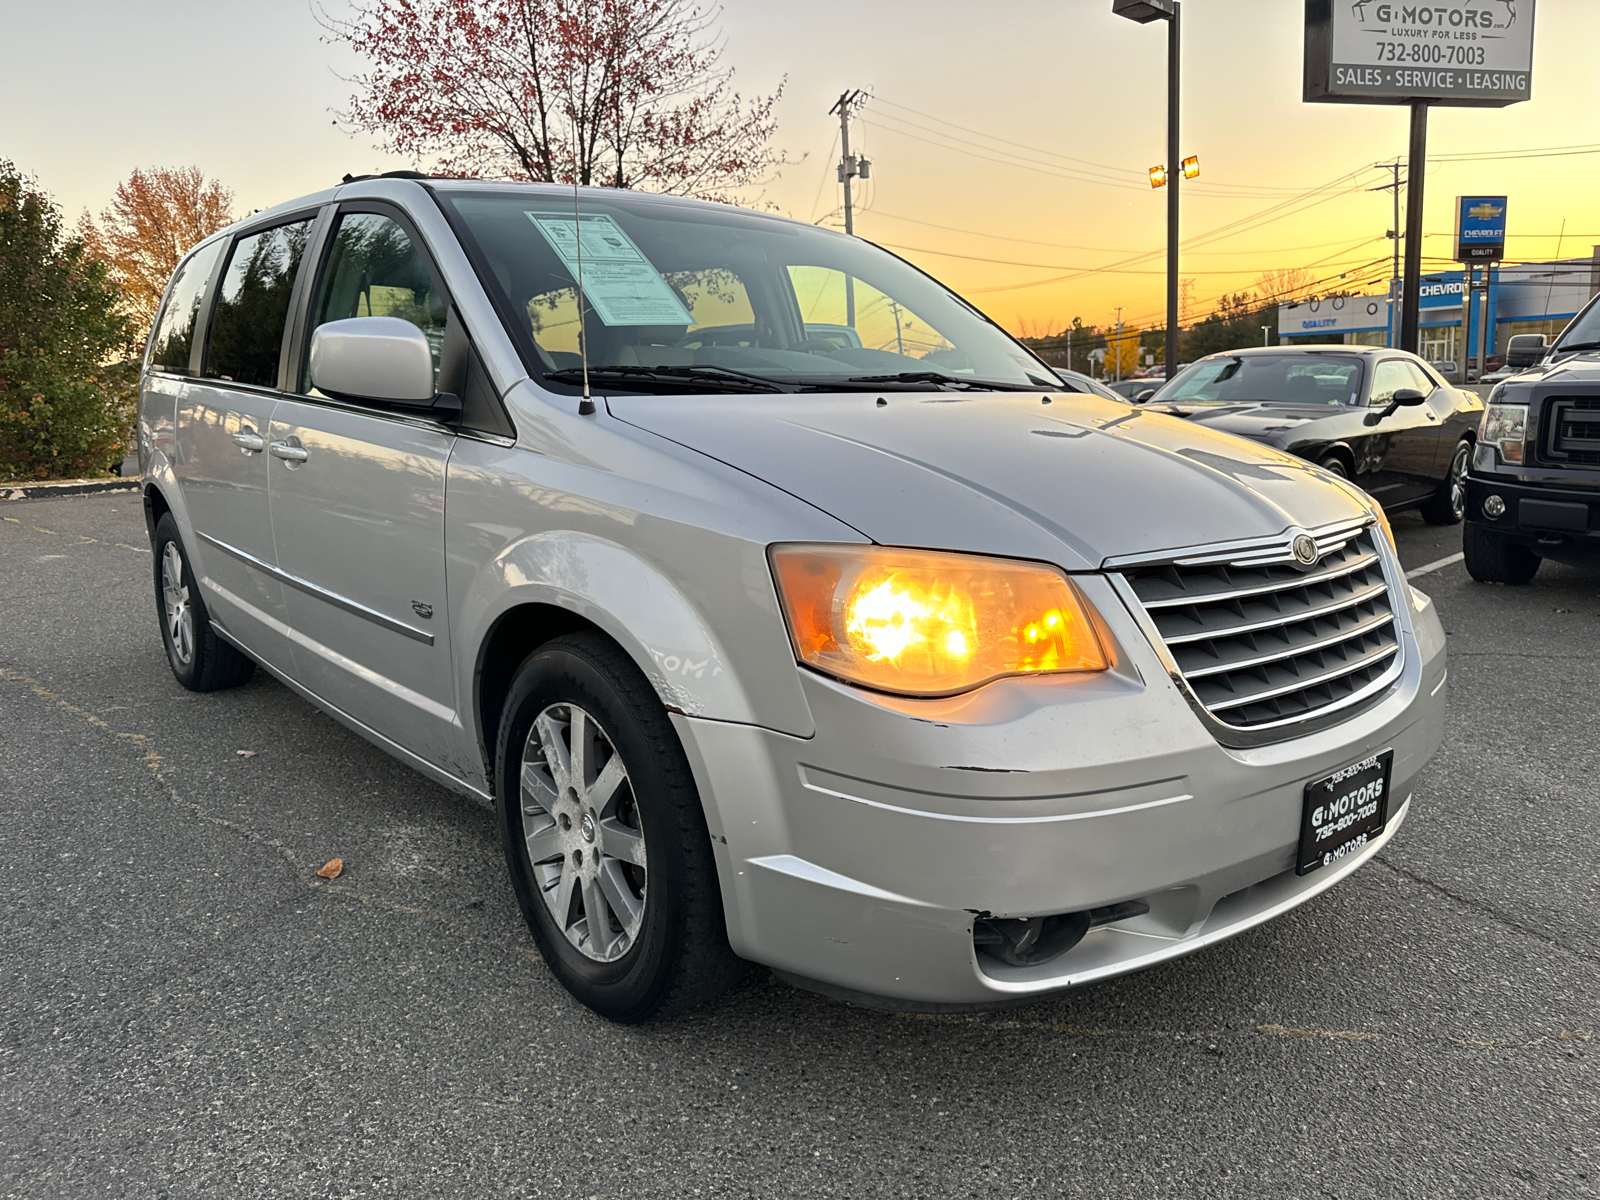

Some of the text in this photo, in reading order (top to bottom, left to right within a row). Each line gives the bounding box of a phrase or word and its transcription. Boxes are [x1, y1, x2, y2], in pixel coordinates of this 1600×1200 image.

[1391, 28, 1477, 41] LUXURY FOR LESS
[1376, 41, 1485, 65] 732-800-7003
[1336, 67, 1526, 91] SALES SERVICE LEASING
[1464, 229, 1503, 238] CHEVROLET
[1471, 249, 1494, 257] QUALITY
[1302, 318, 1337, 329] QUALITY
[1315, 800, 1378, 843] 732-800-7003
